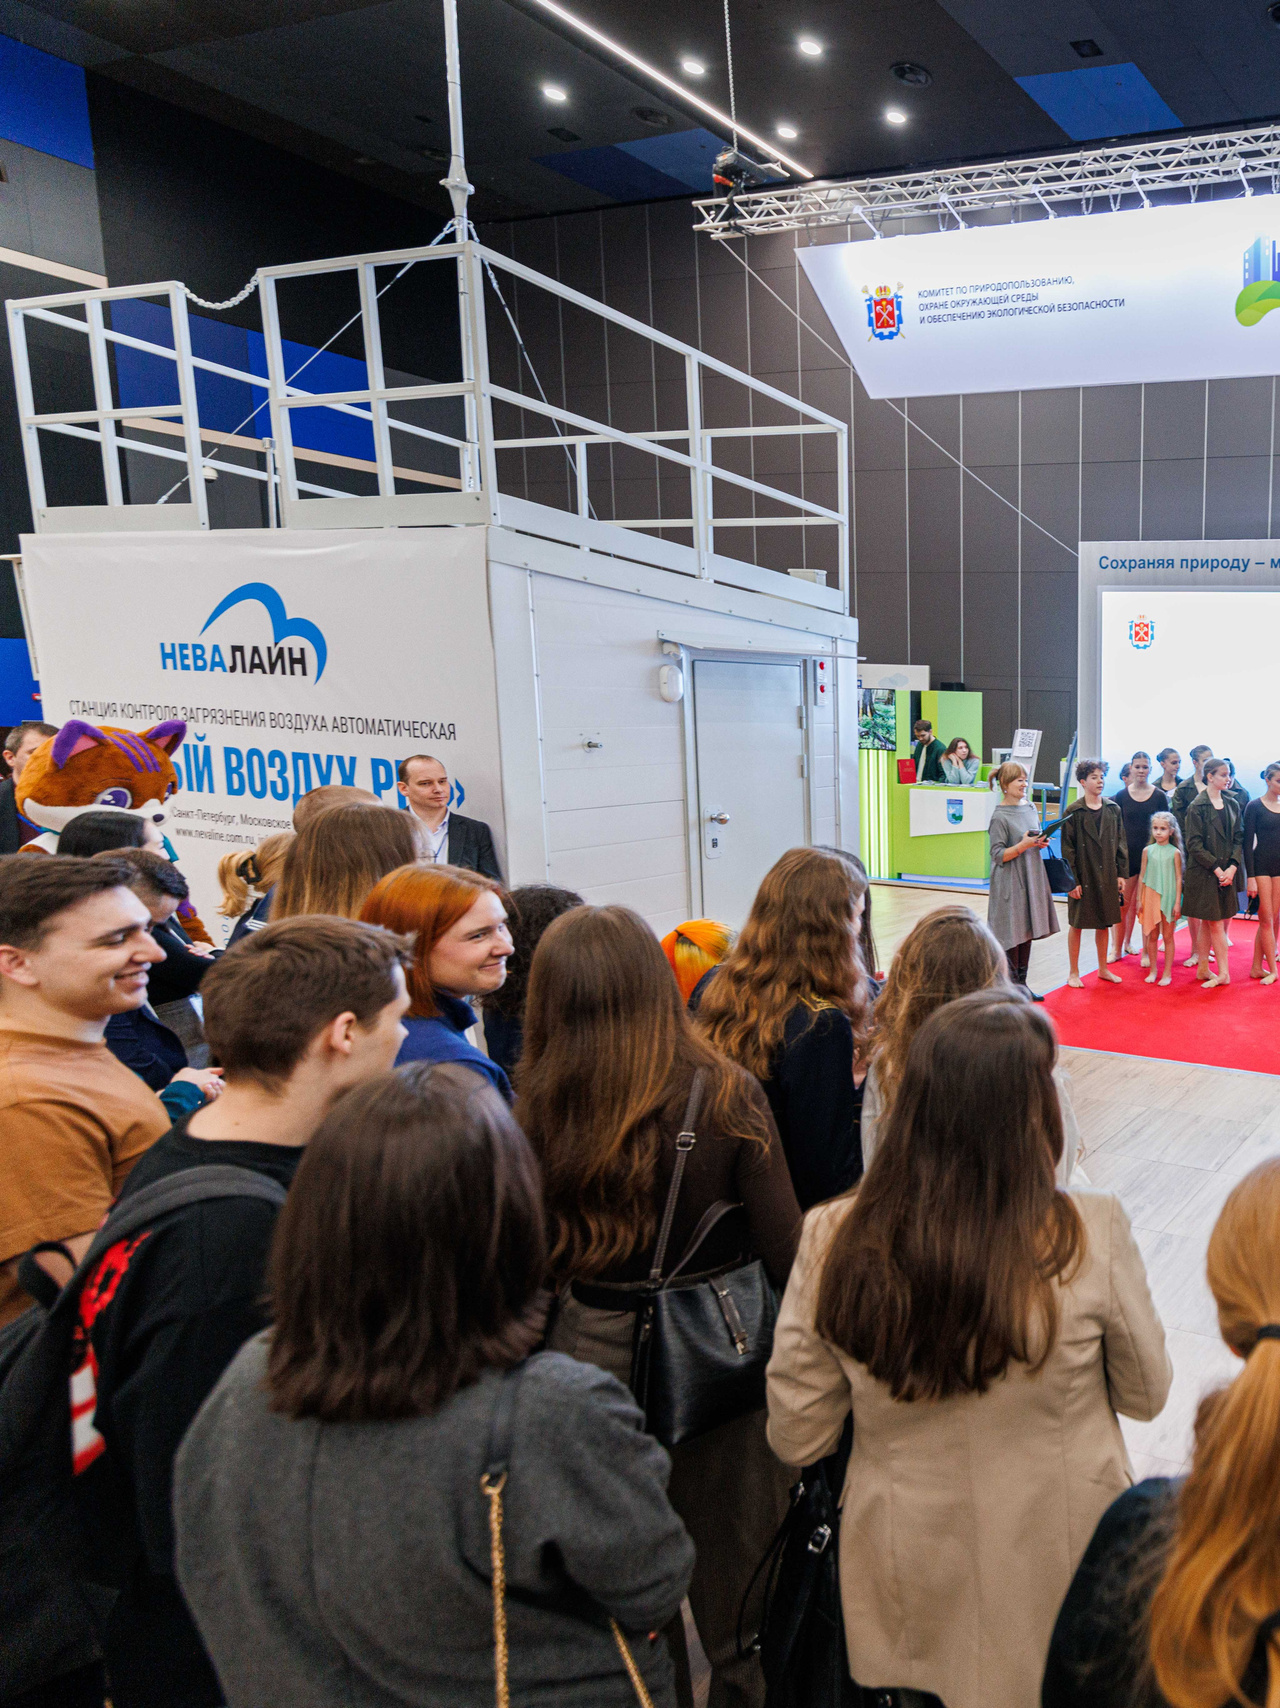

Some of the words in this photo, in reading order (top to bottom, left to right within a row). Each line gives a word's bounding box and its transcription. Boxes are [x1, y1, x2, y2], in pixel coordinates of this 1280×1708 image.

[918, 288, 954, 298] КОМИТЕТ
[956, 286, 968, 296] ПО
[969, 276, 1075, 294] ПРИРОДОПОЛЬЗОВАНИЮ,
[918, 300, 949, 312] ОХРАНЕ
[950, 294, 1009, 308] ОКРУЖАЮЩЕЙ
[1010, 292, 1039, 302] СРЕДЫ
[920, 316, 926, 324] И
[926, 310, 986, 324] ОБЕСПЕЧЕНИЮ
[987, 303, 1055, 319] ЭКОЛОГИЧЕСКОЙ
[1057, 298, 1125, 313] БЕЗОПАСНОСТИ
[1098, 556, 1175, 572] Сохраняя
[1180, 558, 1250, 572] природу
[69, 700, 117, 720] СТАНЦИЯ
[120, 703, 178, 720] КОНТРОЛЯ
[181, 706, 266, 728] ЗАГРЯЗНЕНИЯ
[269, 712, 328, 733] ВОЗДУХА
[332, 716, 456, 740] АВТОМАТИЧЕСКАЯ
[240, 814, 292, 830] Московское
